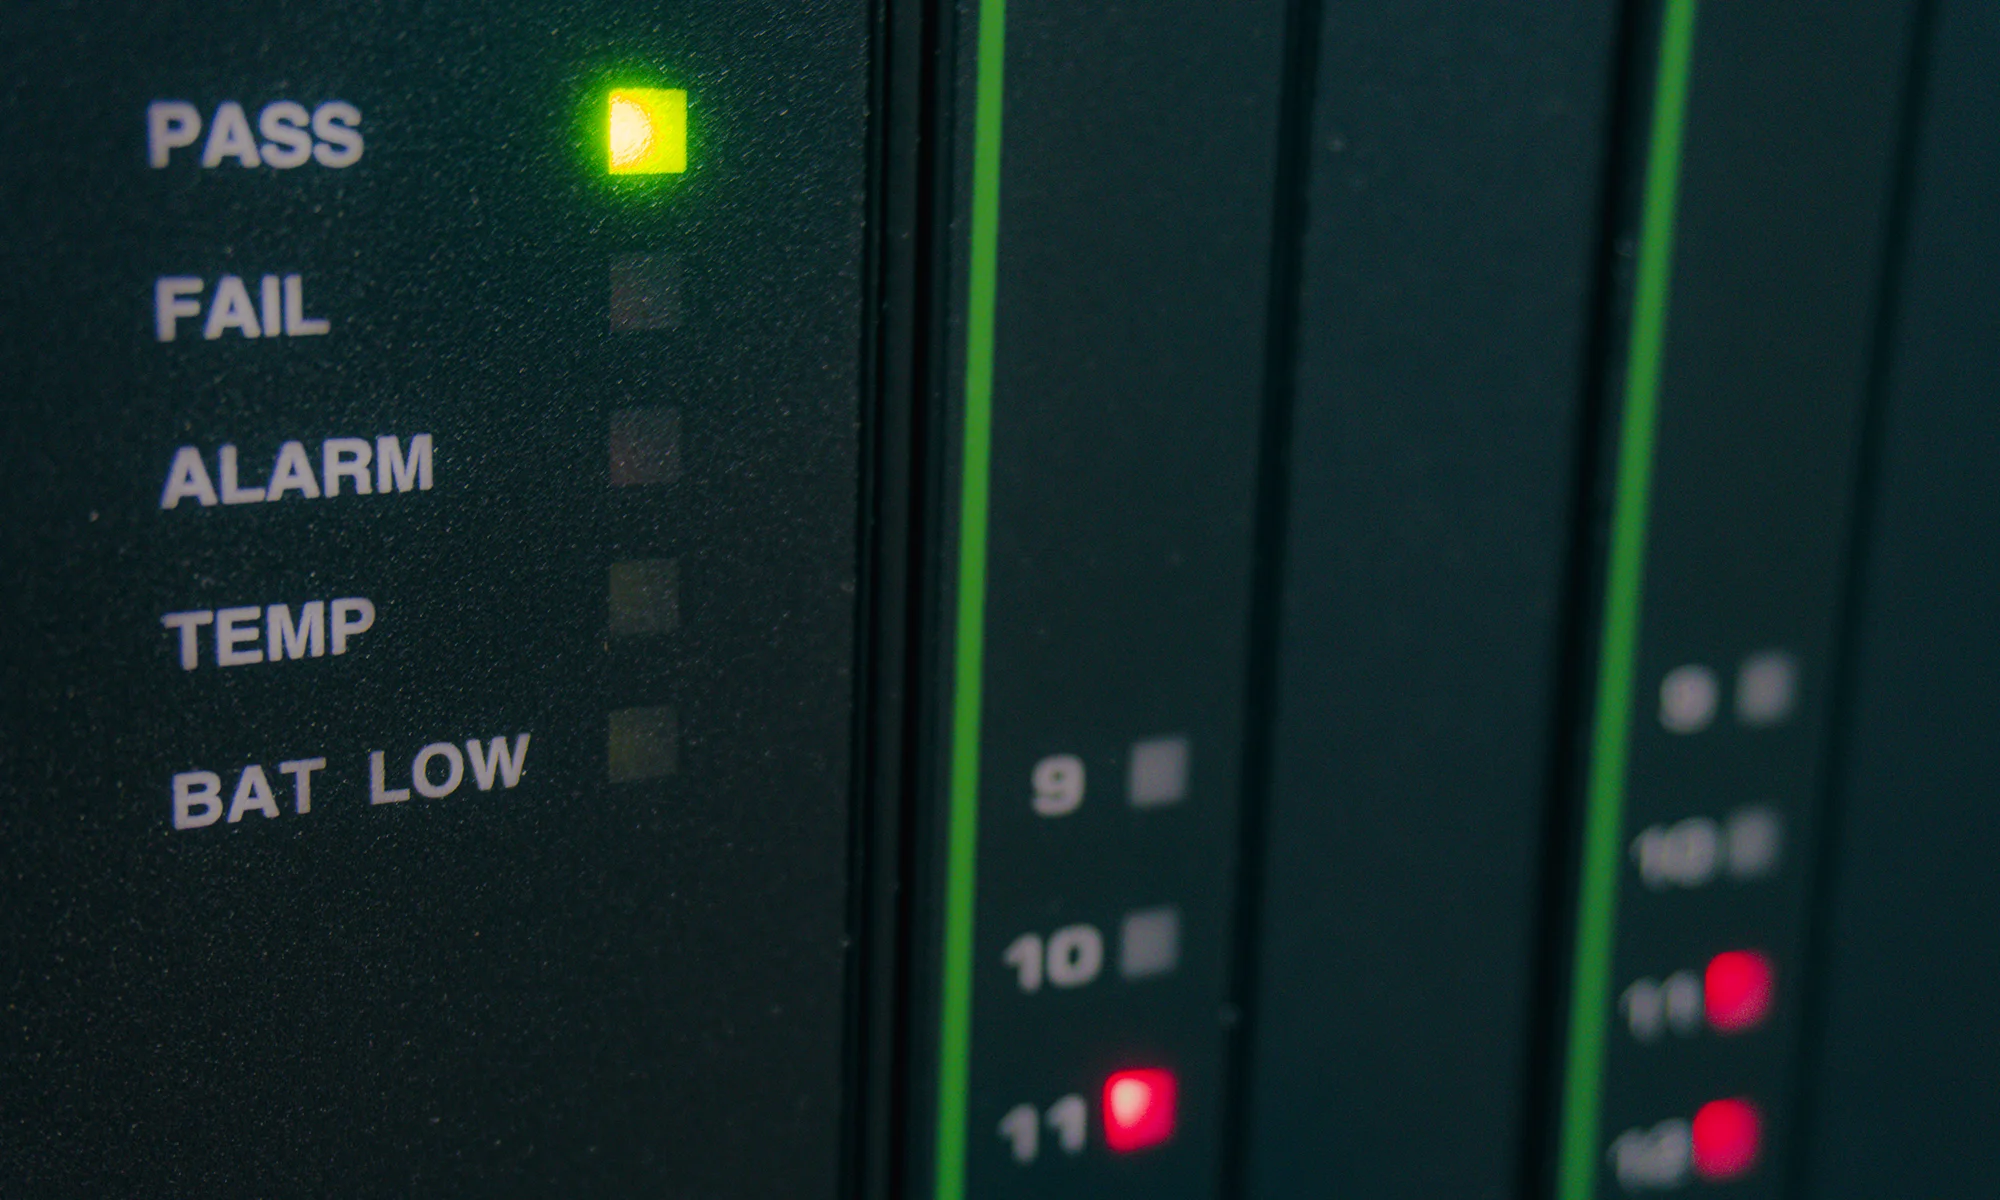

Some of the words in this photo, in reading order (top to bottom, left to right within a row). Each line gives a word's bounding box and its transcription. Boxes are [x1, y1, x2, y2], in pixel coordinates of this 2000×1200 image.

[147, 99, 365, 169] PASS
[154, 273, 331, 342] FAIL
[160, 433, 435, 509] ALARM
[162, 597, 377, 671] TEMP
[171, 757, 328, 830] BAT
[368, 732, 531, 806] LOW
[1032, 754, 1086, 817] 9
[1004, 924, 1104, 992] 10
[1000, 1095, 1089, 1162] 11
